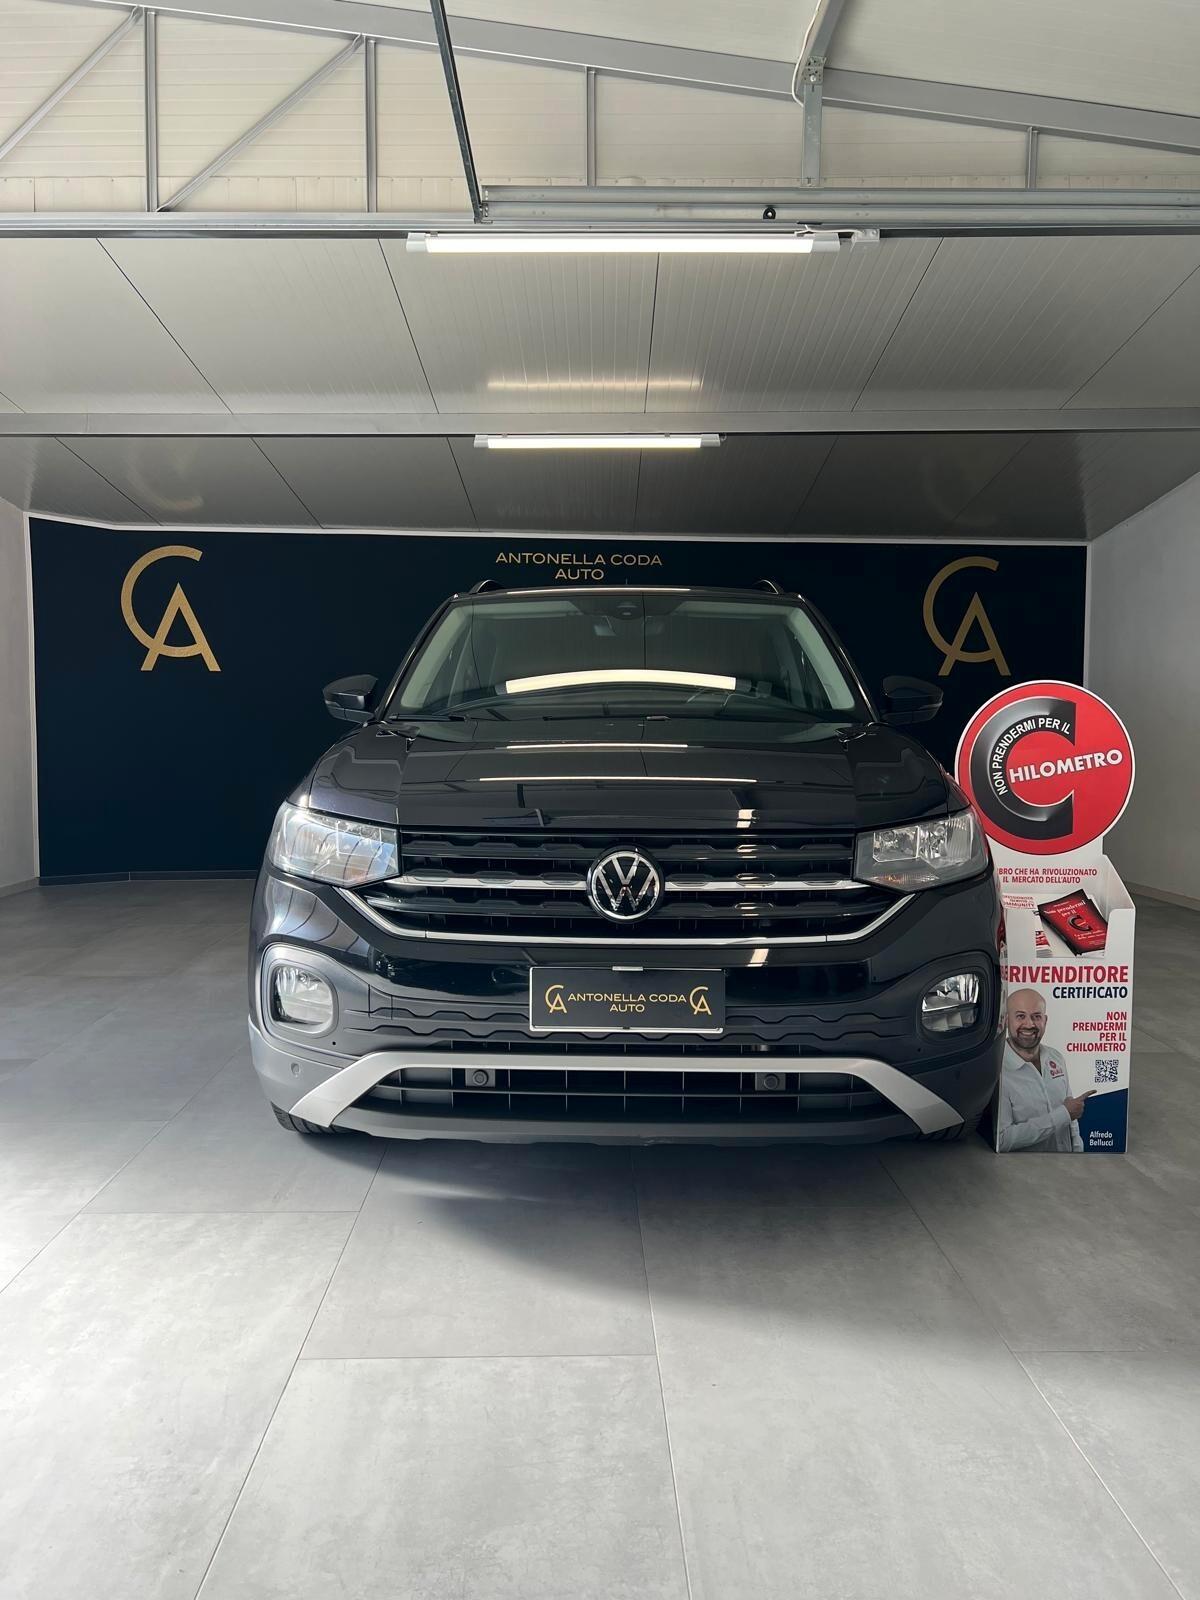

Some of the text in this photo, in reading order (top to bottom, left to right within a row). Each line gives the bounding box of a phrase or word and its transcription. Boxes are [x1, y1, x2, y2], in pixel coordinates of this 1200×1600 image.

[495, 552, 663, 566] ANTONELLA CODA
[554, 568, 605, 580] AUTO
[992, 717, 1071, 796] NON PRENDERMI PER IL
[1009, 749, 1123, 783] HILOMETRO
[1014, 867, 1028, 876] CHE
[1029, 867, 1040, 876] HA
[1042, 868, 1098, 876] RIVOLUZIONATO
[1002, 875, 1081, 884] IL MERCATO DELL'AUTO
[1009, 965, 1129, 984] RIVENDITORE
[1052, 986, 1128, 999] CERTIFICATO
[567, 993, 647, 1002] ANTONELLA
[649, 993, 687, 1003] CODA
[609, 1003, 645, 1012] AUTO
[1106, 1011, 1127, 1021] NON
[1072, 1022, 1127, 1032] PRENDERMI
[1099, 1033, 1127, 1041] PER IL
[1066, 1042, 1127, 1052] CHILOMETRO
[1089, 1130, 1113, 1139] Alfredo
[1089, 1139, 1114, 1147] Bellucci
